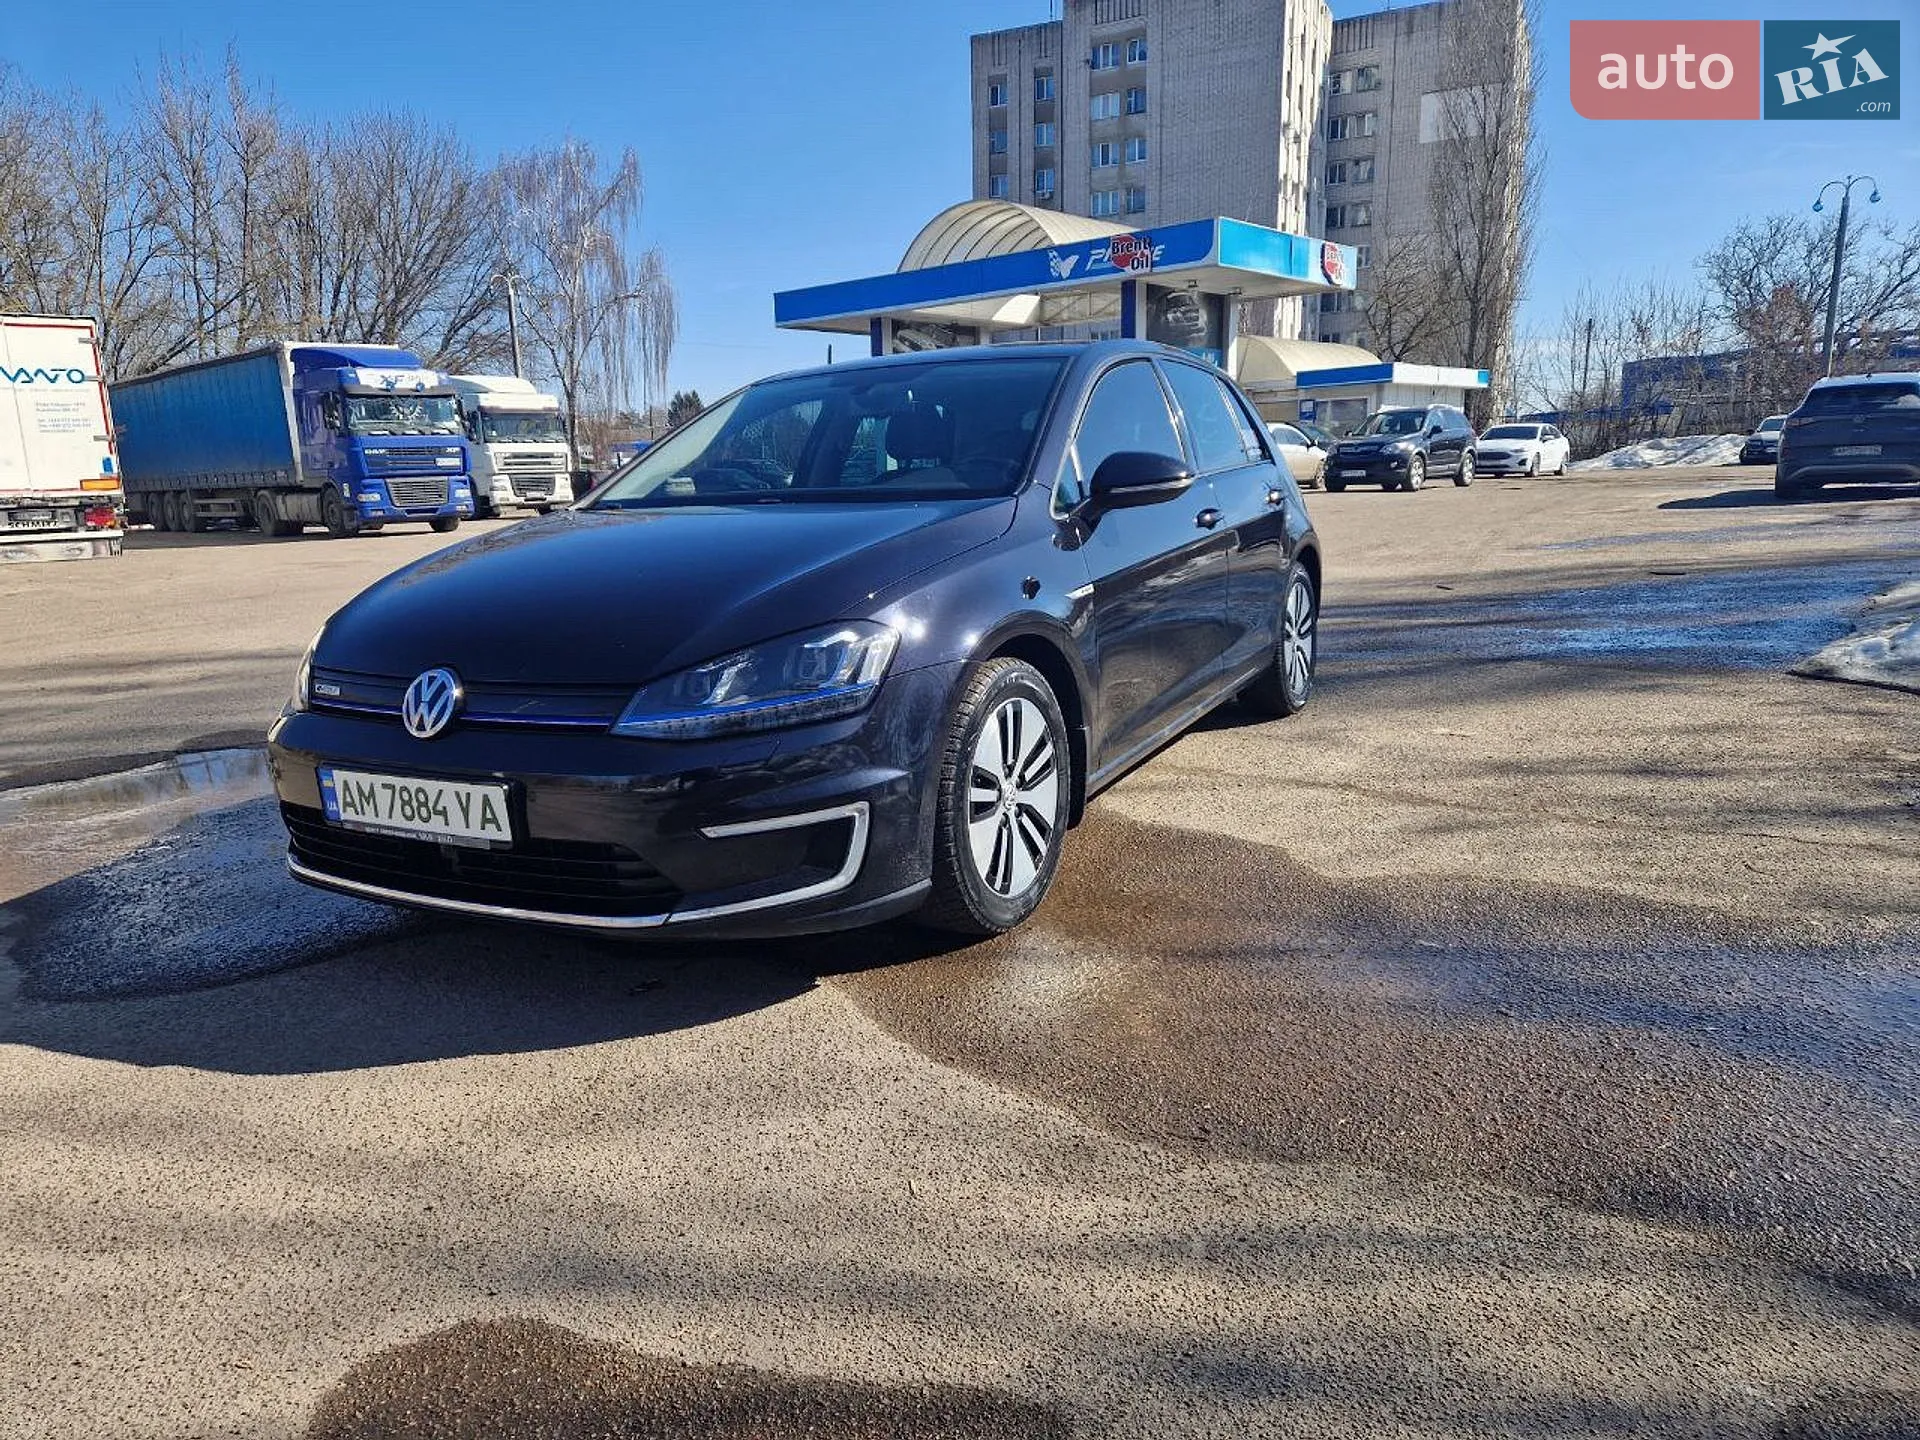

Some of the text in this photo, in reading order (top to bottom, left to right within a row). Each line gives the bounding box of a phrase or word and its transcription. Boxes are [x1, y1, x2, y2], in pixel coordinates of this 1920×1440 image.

[1111, 236, 1152, 255] Brent
[1131, 254, 1149, 271] Oil
[342, 779, 502, 832] AM 7884 YA
